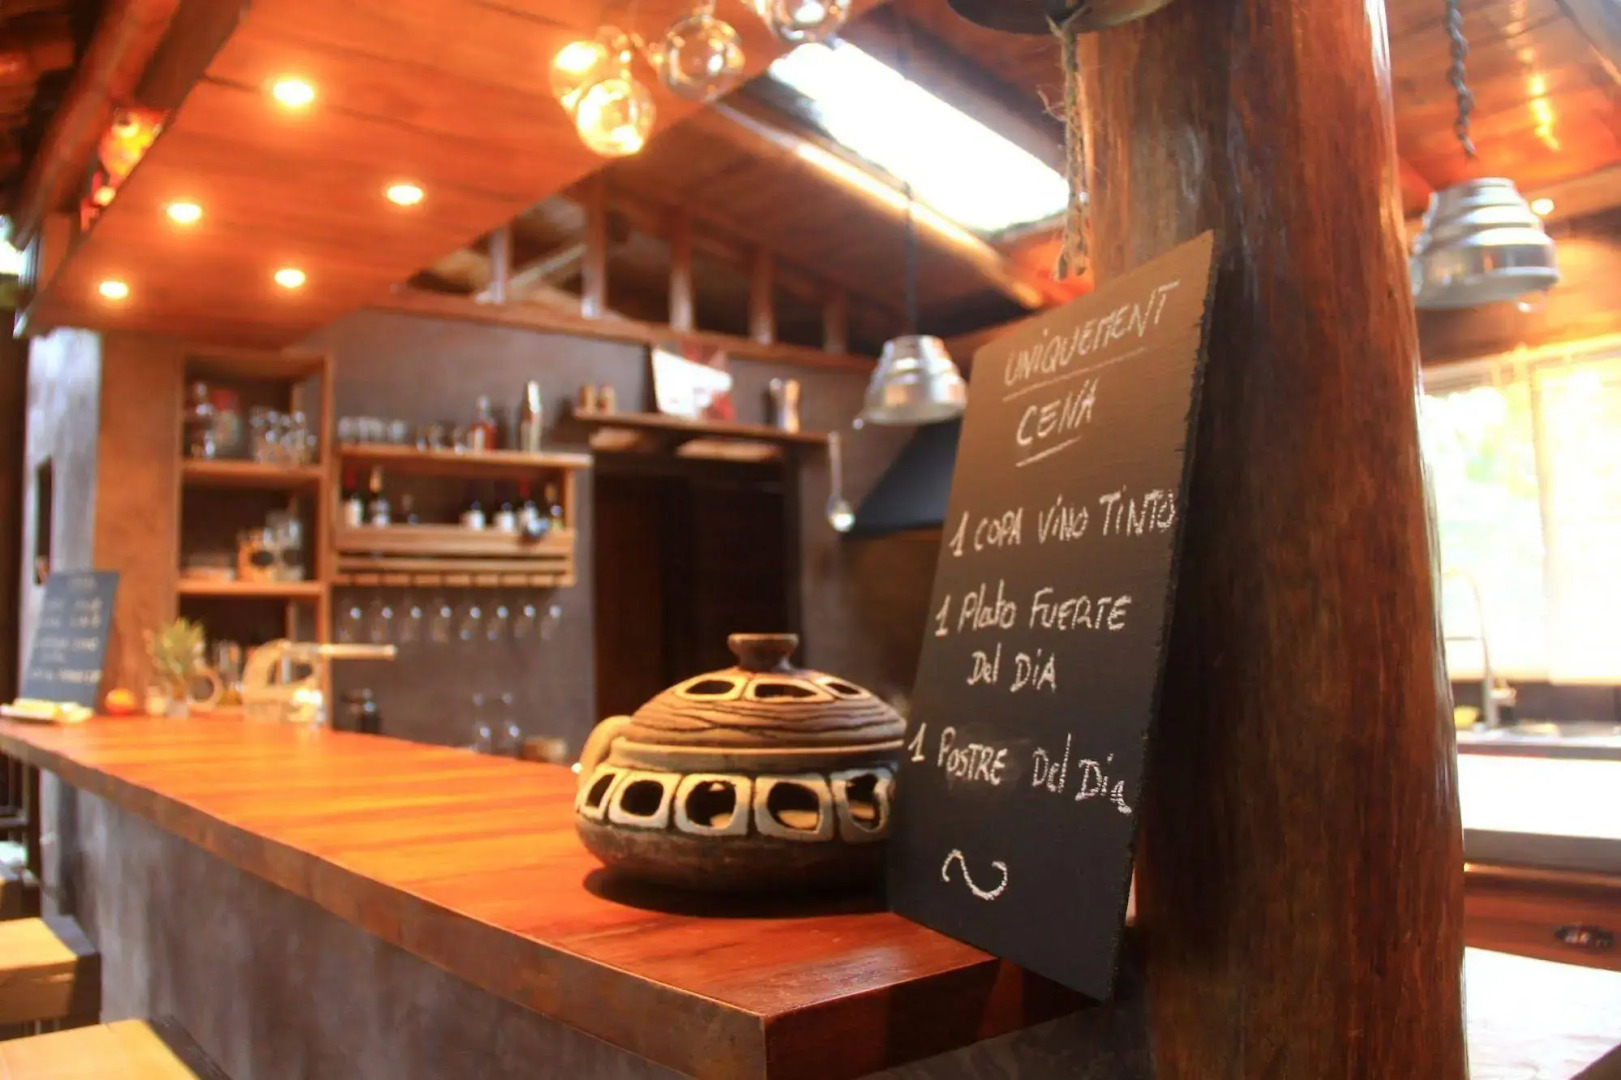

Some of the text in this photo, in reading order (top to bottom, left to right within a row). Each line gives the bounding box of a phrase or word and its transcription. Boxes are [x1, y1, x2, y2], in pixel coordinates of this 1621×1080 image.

[949, 510, 969, 557] 1
[974, 507, 1023, 551] COPA
[934, 594, 951, 636] 1
[908, 722, 927, 762] 1
